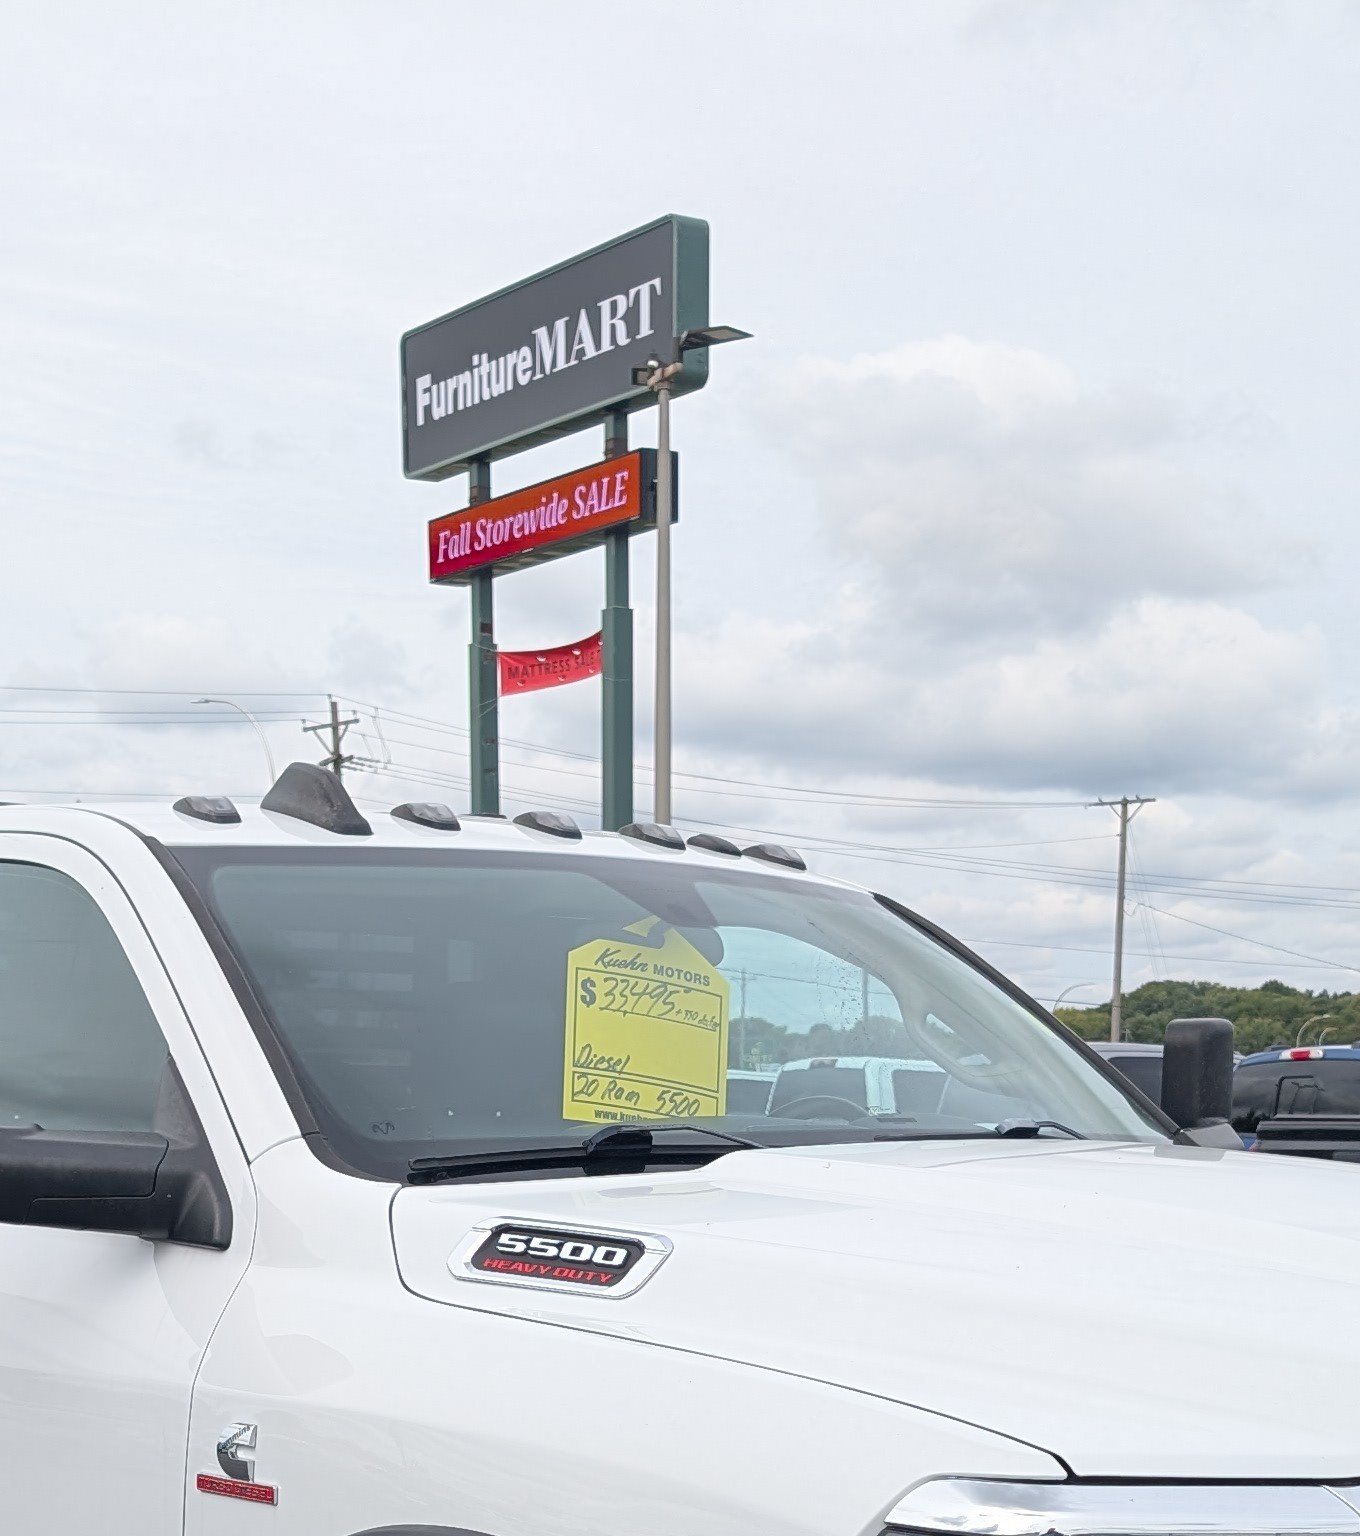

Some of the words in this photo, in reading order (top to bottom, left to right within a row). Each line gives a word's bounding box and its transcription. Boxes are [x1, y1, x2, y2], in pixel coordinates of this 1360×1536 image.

[415, 277, 662, 427] FurnitureMART
[436, 520, 472, 564] Fall
[473, 491, 570, 551] Storewide
[572, 469, 629, 520] SALE
[507, 658, 571, 680] MATTRESS
[594, 947, 648, 973] Kuehn
[653, 963, 711, 987] MOTORS
[575, 1043, 631, 1076] Diesel
[574, 1073, 600, 1098] 20
[601, 1079, 641, 1106] Ram
[655, 1089, 701, 1117] 5500
[495, 1233, 628, 1266] 5500
[483, 1257, 551, 1275] HEAVY
[552, 1266, 615, 1284] DUTY
